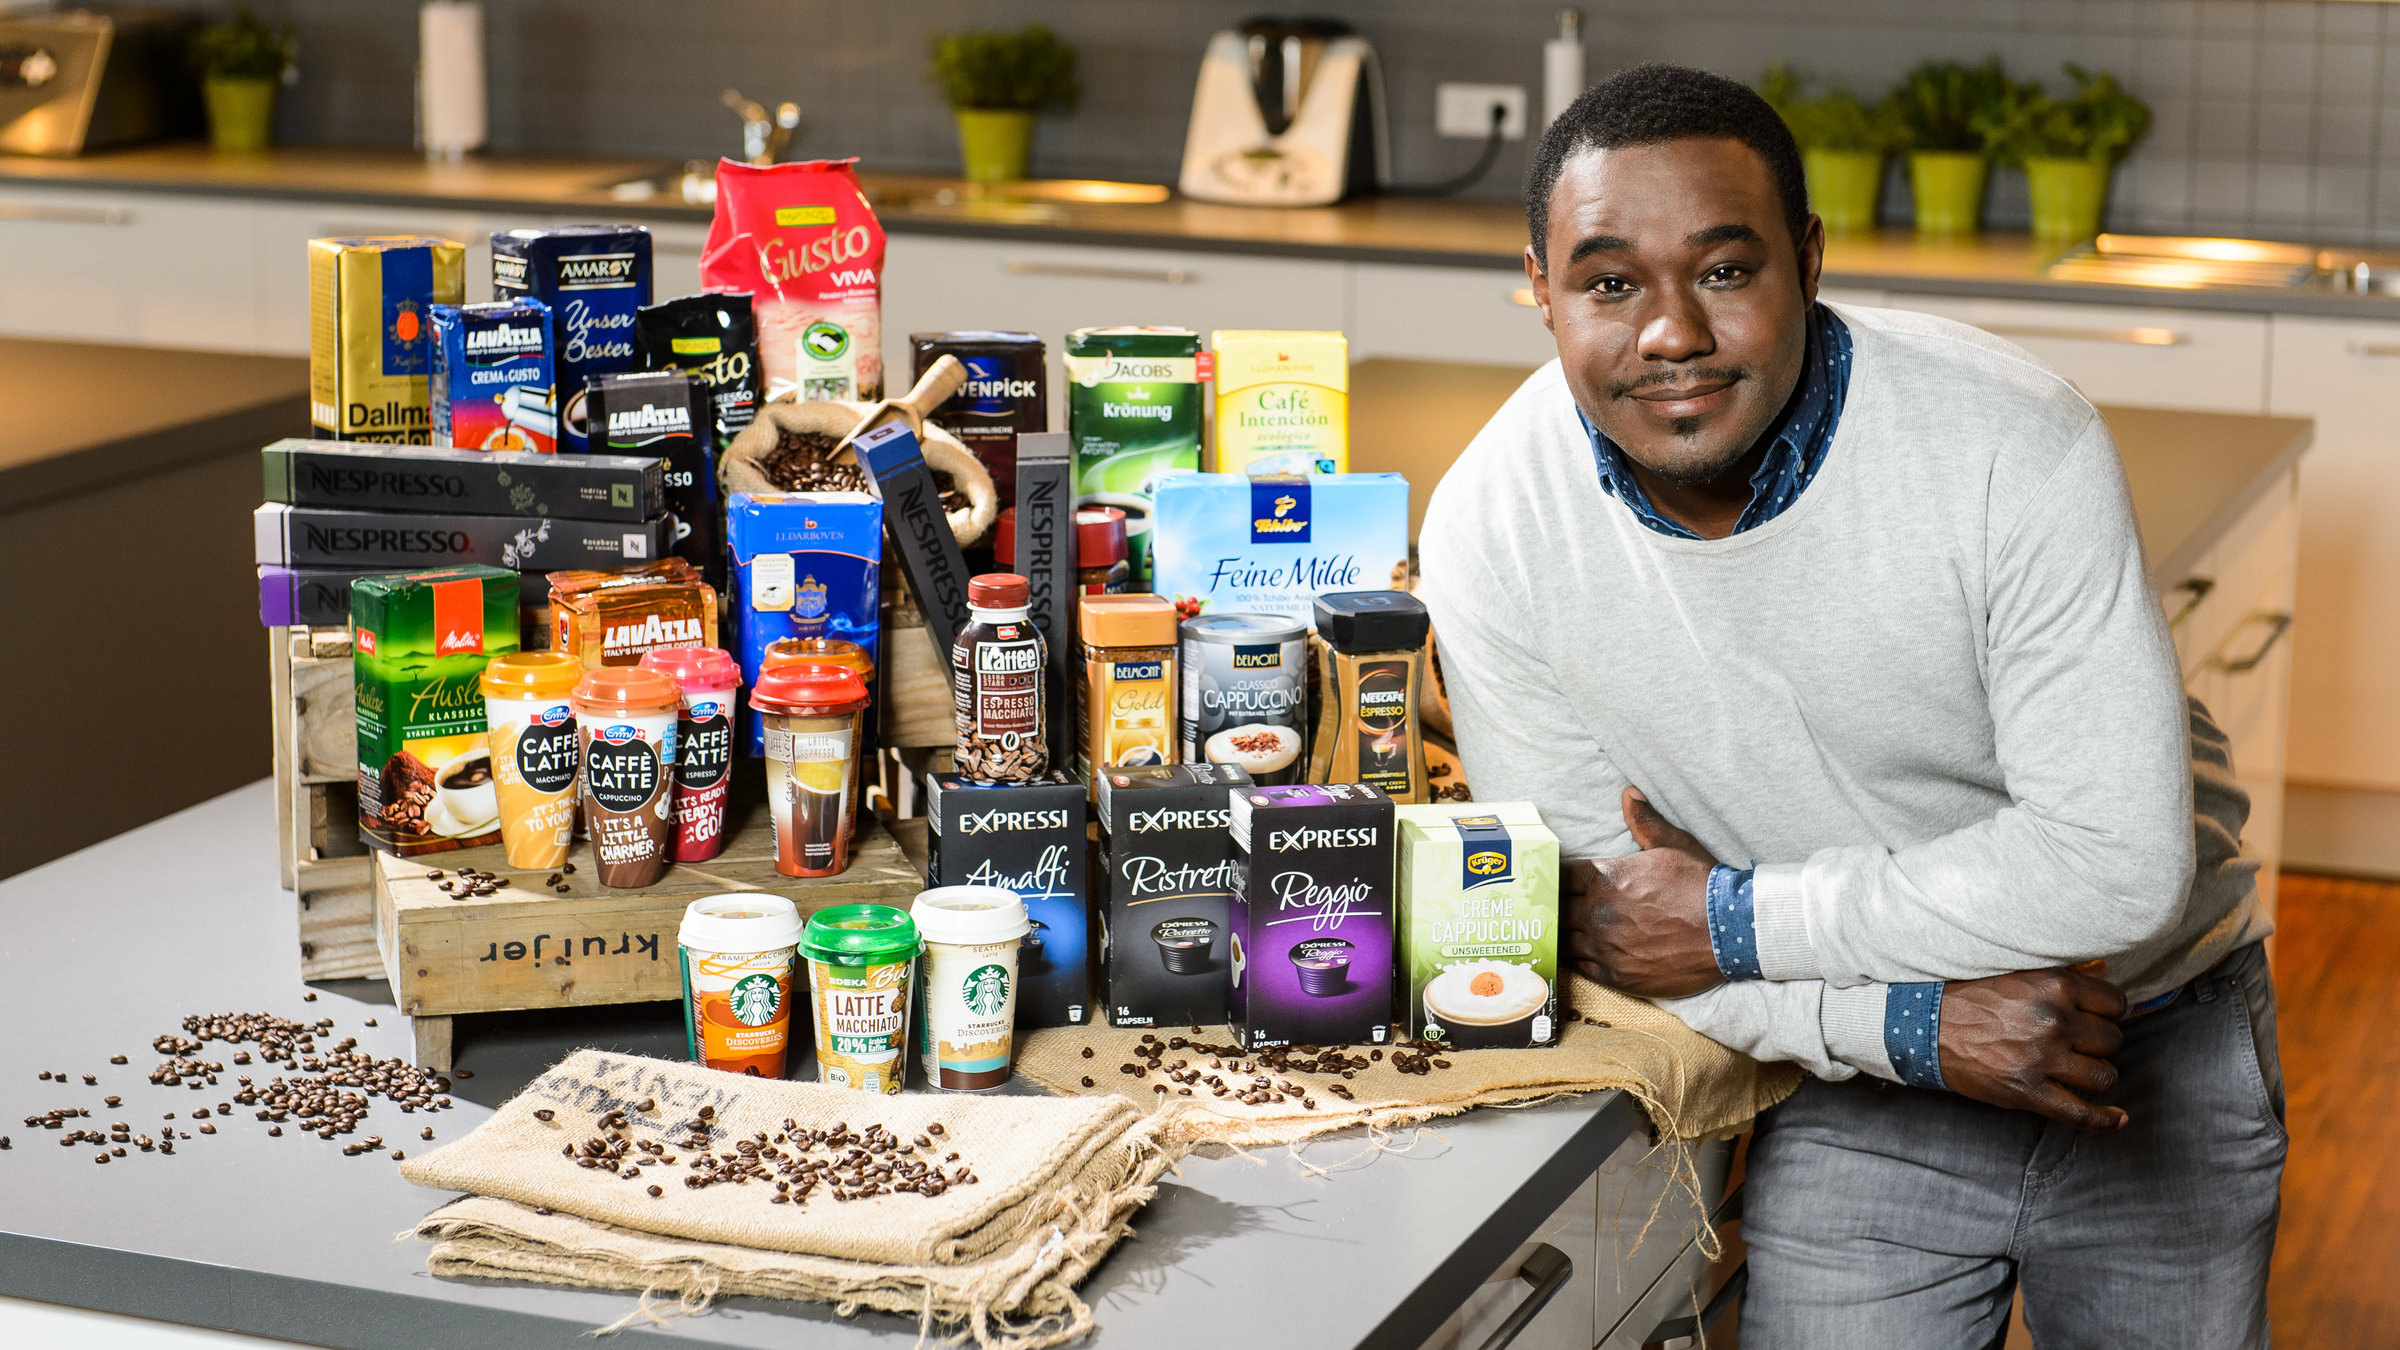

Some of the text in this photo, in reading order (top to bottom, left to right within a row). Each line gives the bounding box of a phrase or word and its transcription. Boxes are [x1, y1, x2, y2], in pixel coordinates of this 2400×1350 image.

[760, 225, 870, 284] Gusto
[561, 259, 633, 278] AMAROY
[829, 268, 876, 288] VIVA
[565, 299, 635, 332] Unser
[466, 323, 543, 349] LAVAZZA
[563, 329, 634, 362] Bester
[471, 367, 541, 385] CREMA GUSTO
[1104, 360, 1173, 379] JACOBS
[1258, 389, 1310, 413] Café
[608, 403, 691, 430] LAVAZZA
[1103, 402, 1173, 422] Krönung
[1239, 411, 1329, 428] Intención
[1209, 554, 1361, 592] Feine Milde
[603, 614, 703, 649] LAVAZZA
[981, 646, 1036, 670] Kaffee
[1236, 653, 1280, 667] BELMONT
[1116, 665, 1161, 680] BELMONT
[1238, 679, 1279, 691] CLASSICO
[983, 696, 1035, 709] ESPRESSO
[1112, 689, 1166, 718] Gold
[1203, 686, 1303, 710] CAPPUCCINO
[1360, 688, 1405, 704] NESCAFÉ
[983, 706, 1034, 720] MACCHIATO
[1360, 705, 1404, 718] ESPRESSO
[406, 729, 436, 739] STÄRKE
[522, 729, 579, 755] CAFFÈ
[523, 750, 579, 772] LATTE
[589, 751, 652, 772] CAFFÈ
[675, 748, 729, 767] ATTE
[536, 772, 572, 785] MACCHIATO
[590, 769, 652, 790] LATTE
[686, 769, 718, 779] ESPRESSO
[598, 792, 643, 802] CAPPUCCINO
[675, 785, 727, 809] IT'S READY
[525, 818, 544, 833] TO
[603, 815, 644, 832] IT'S A
[695, 806, 724, 843] GO!
[959, 808, 1068, 836] EXPRESSI
[1129, 806, 1230, 835] EXPRESS
[602, 827, 649, 846] LITTLE
[1269, 825, 1378, 853] EXPRESSI
[600, 838, 655, 862] CHARMER
[1471, 853, 1504, 868] Krüger
[965, 844, 1071, 901] Amalfi
[1121, 856, 1231, 897] Ristrett
[1271, 871, 1373, 932] Reggio
[1461, 896, 1514, 919] CRÈME
[1159, 928, 1212, 938] Ristretto
[1161, 920, 1209, 928] EXPRESSI
[1431, 918, 1542, 943] CAPPUCCINO
[711, 953, 750, 962] CARAMEL
[973, 943, 1007, 953] SEATTLE
[1301, 949, 1343, 961] Reggio
[1451, 945, 1521, 956] UNSWEETENED
[829, 977, 868, 988] EDEKA
[870, 963, 911, 989] Bio
[835, 995, 886, 1017] LATTE
[1117, 1006, 1130, 1017] 16
[836, 1015, 898, 1034] MACCHIATO
[967, 1020, 1005, 1029] STARBUCKS
[1117, 1016, 1154, 1026] KAPSELN
[736, 1029, 776, 1039] STARBUCKS
[1253, 1030, 1267, 1040] 16
[1427, 1030, 1438, 1040] 10
[837, 1037, 867, 1054] 20%
